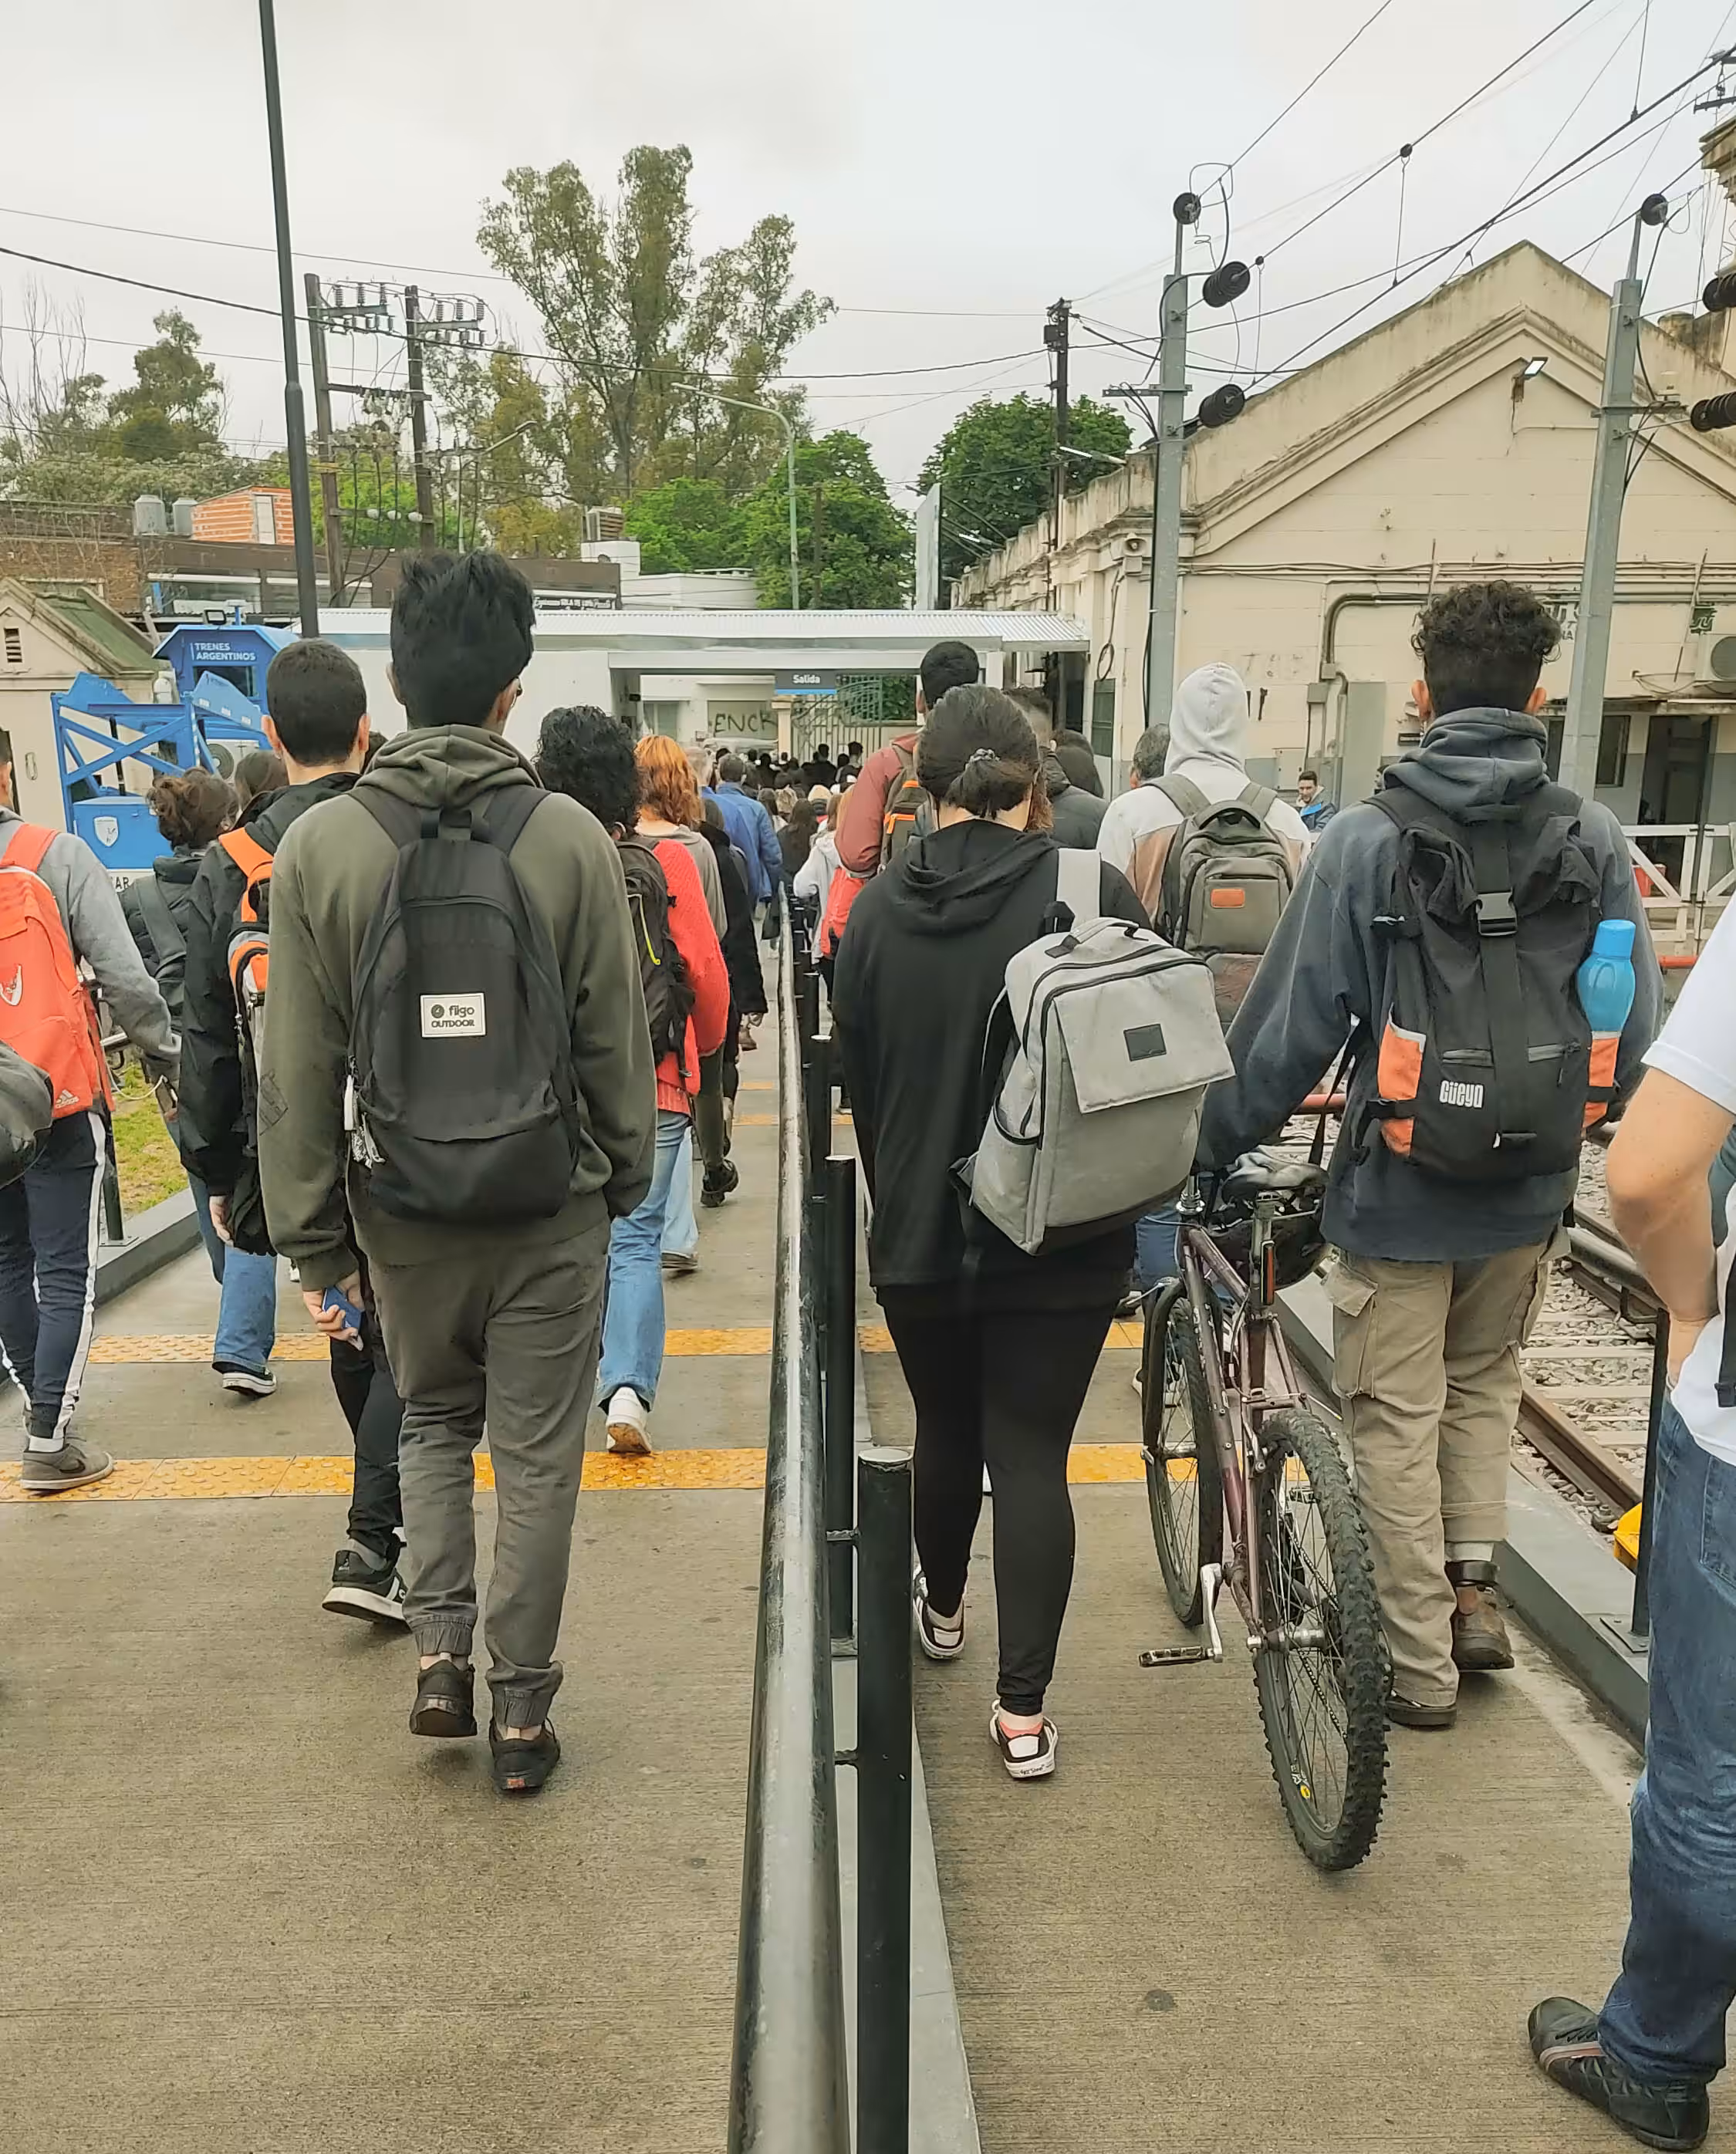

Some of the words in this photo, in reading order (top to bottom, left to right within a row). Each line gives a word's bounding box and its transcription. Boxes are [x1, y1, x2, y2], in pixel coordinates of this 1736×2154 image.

[194, 642, 231, 651] TRENES
[195, 652, 257, 661] ARGENTINOS
[792, 674, 821, 684] Salida
[431, 1019, 475, 1028] OUTDOOR
